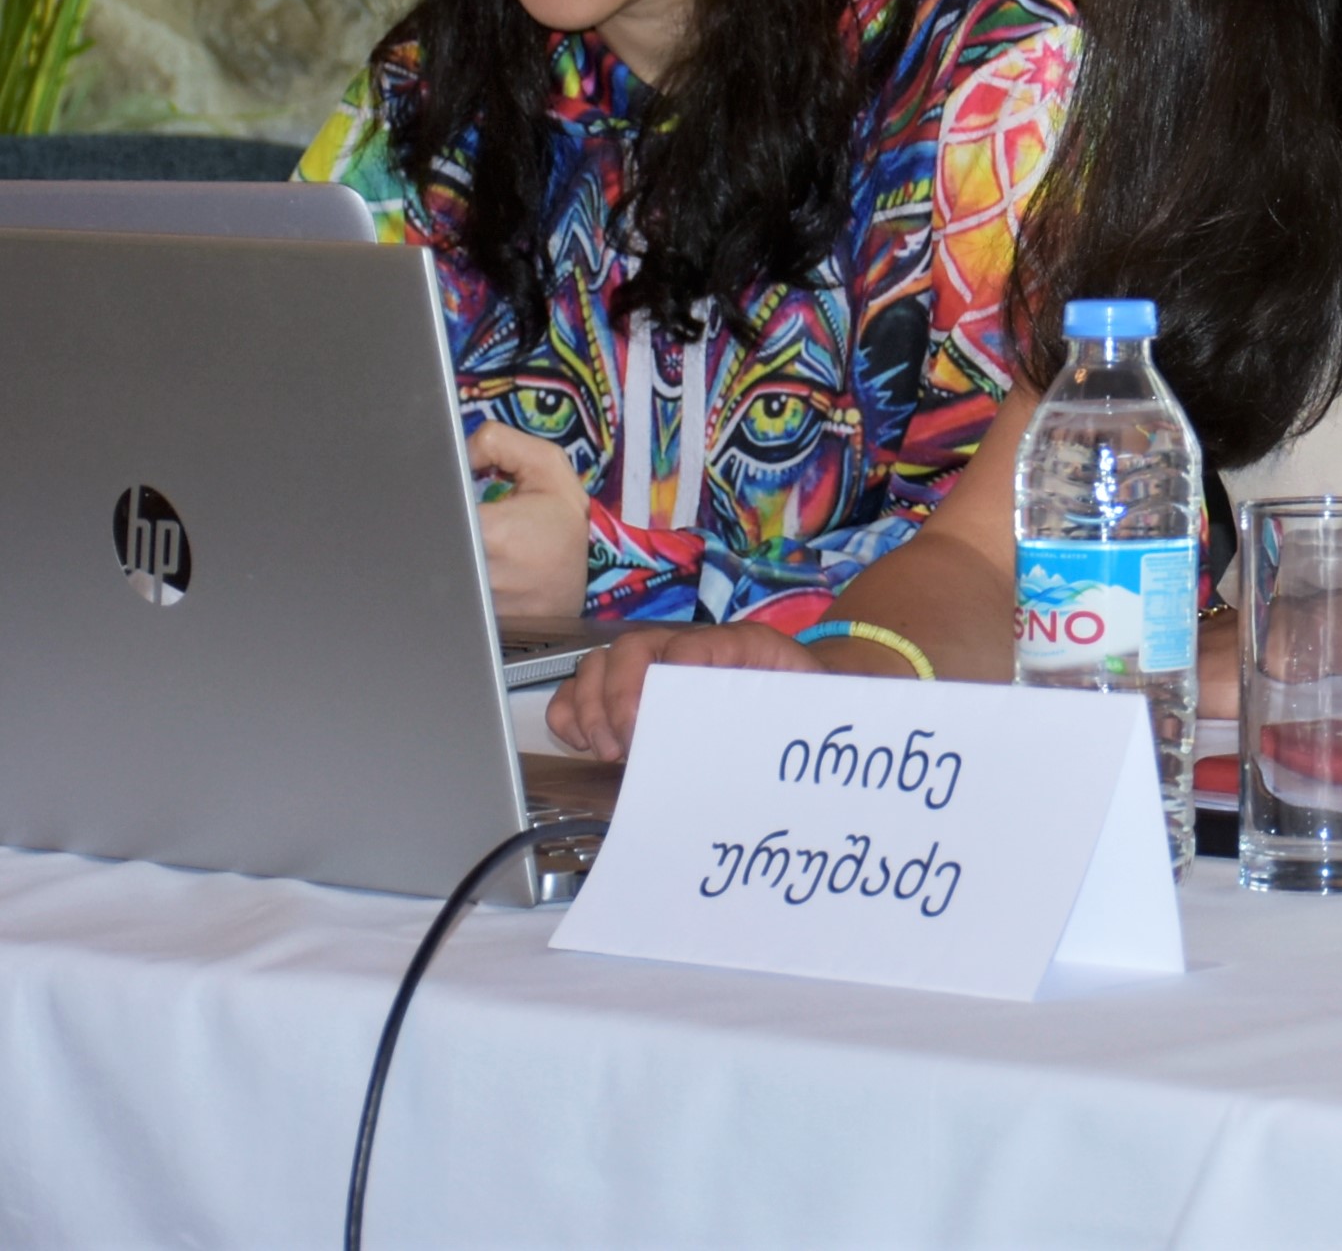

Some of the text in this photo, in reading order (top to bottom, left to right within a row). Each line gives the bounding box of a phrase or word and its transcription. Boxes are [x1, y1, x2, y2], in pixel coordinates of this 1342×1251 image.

[126, 485, 181, 605] hp
[778, 724, 962, 810] ირინე
[699, 829, 962, 917] ურუშაძე
